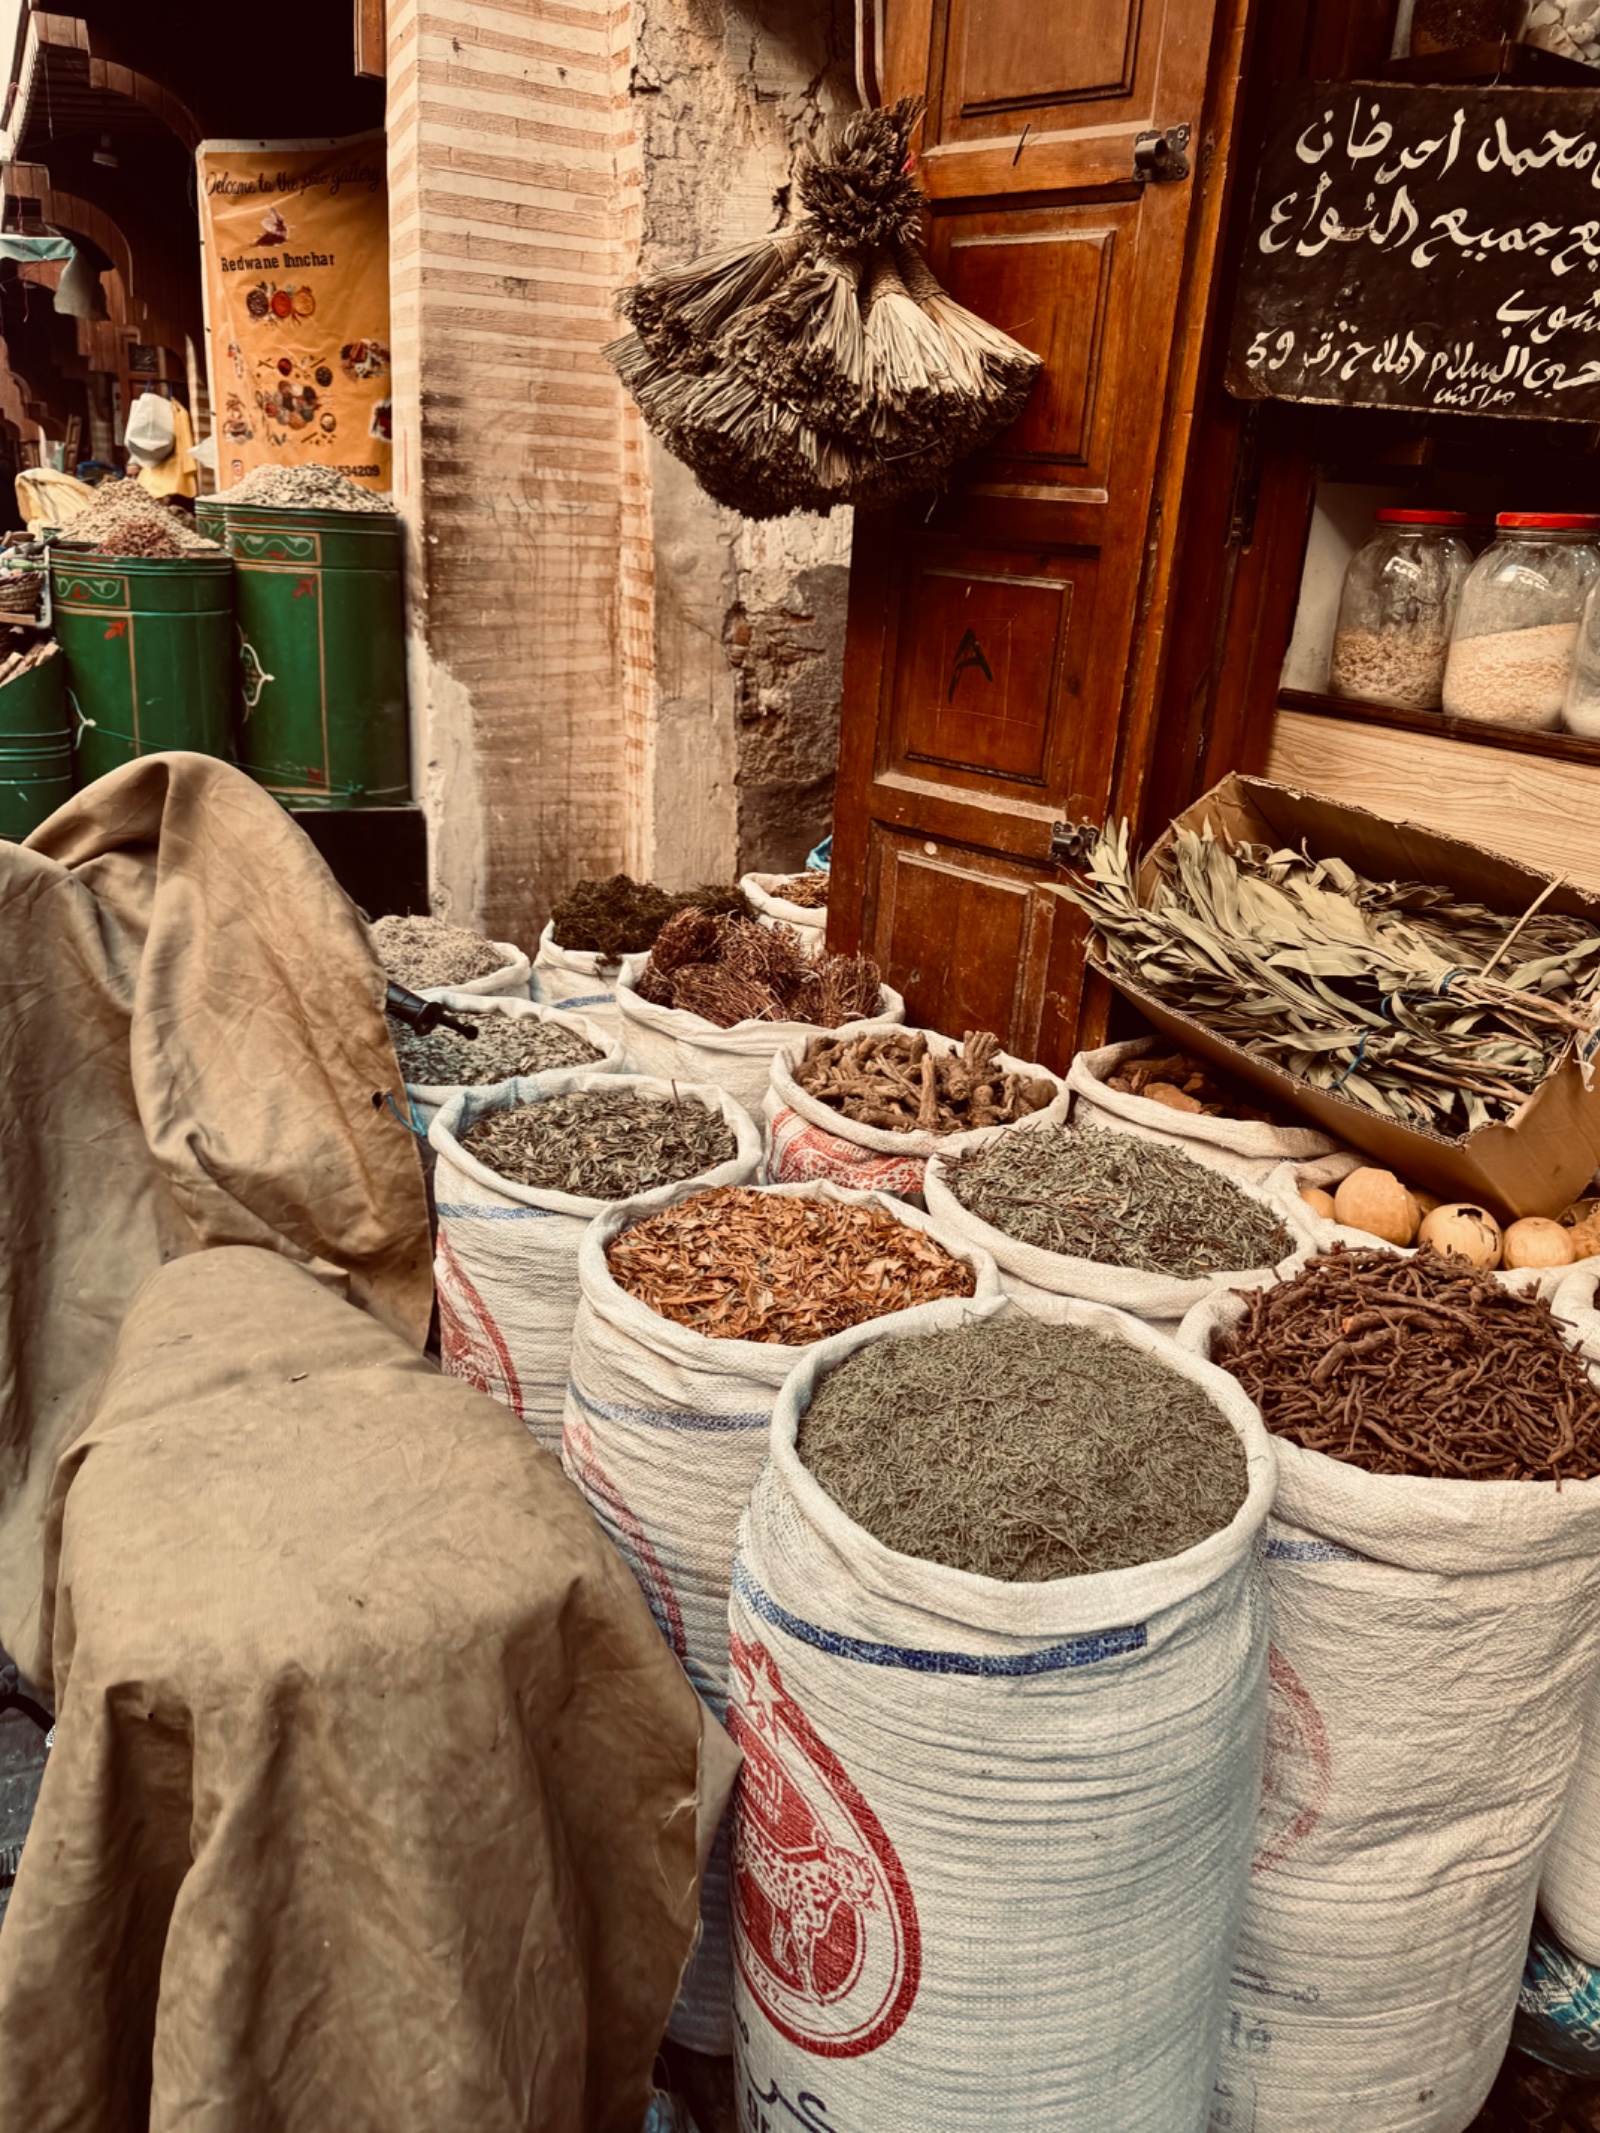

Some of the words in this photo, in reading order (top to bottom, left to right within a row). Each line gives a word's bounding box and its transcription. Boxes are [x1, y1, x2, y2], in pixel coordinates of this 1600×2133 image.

[257, 172, 274, 193] to
[276, 171, 298, 193] the
[220, 255, 280, 272] Redwane
